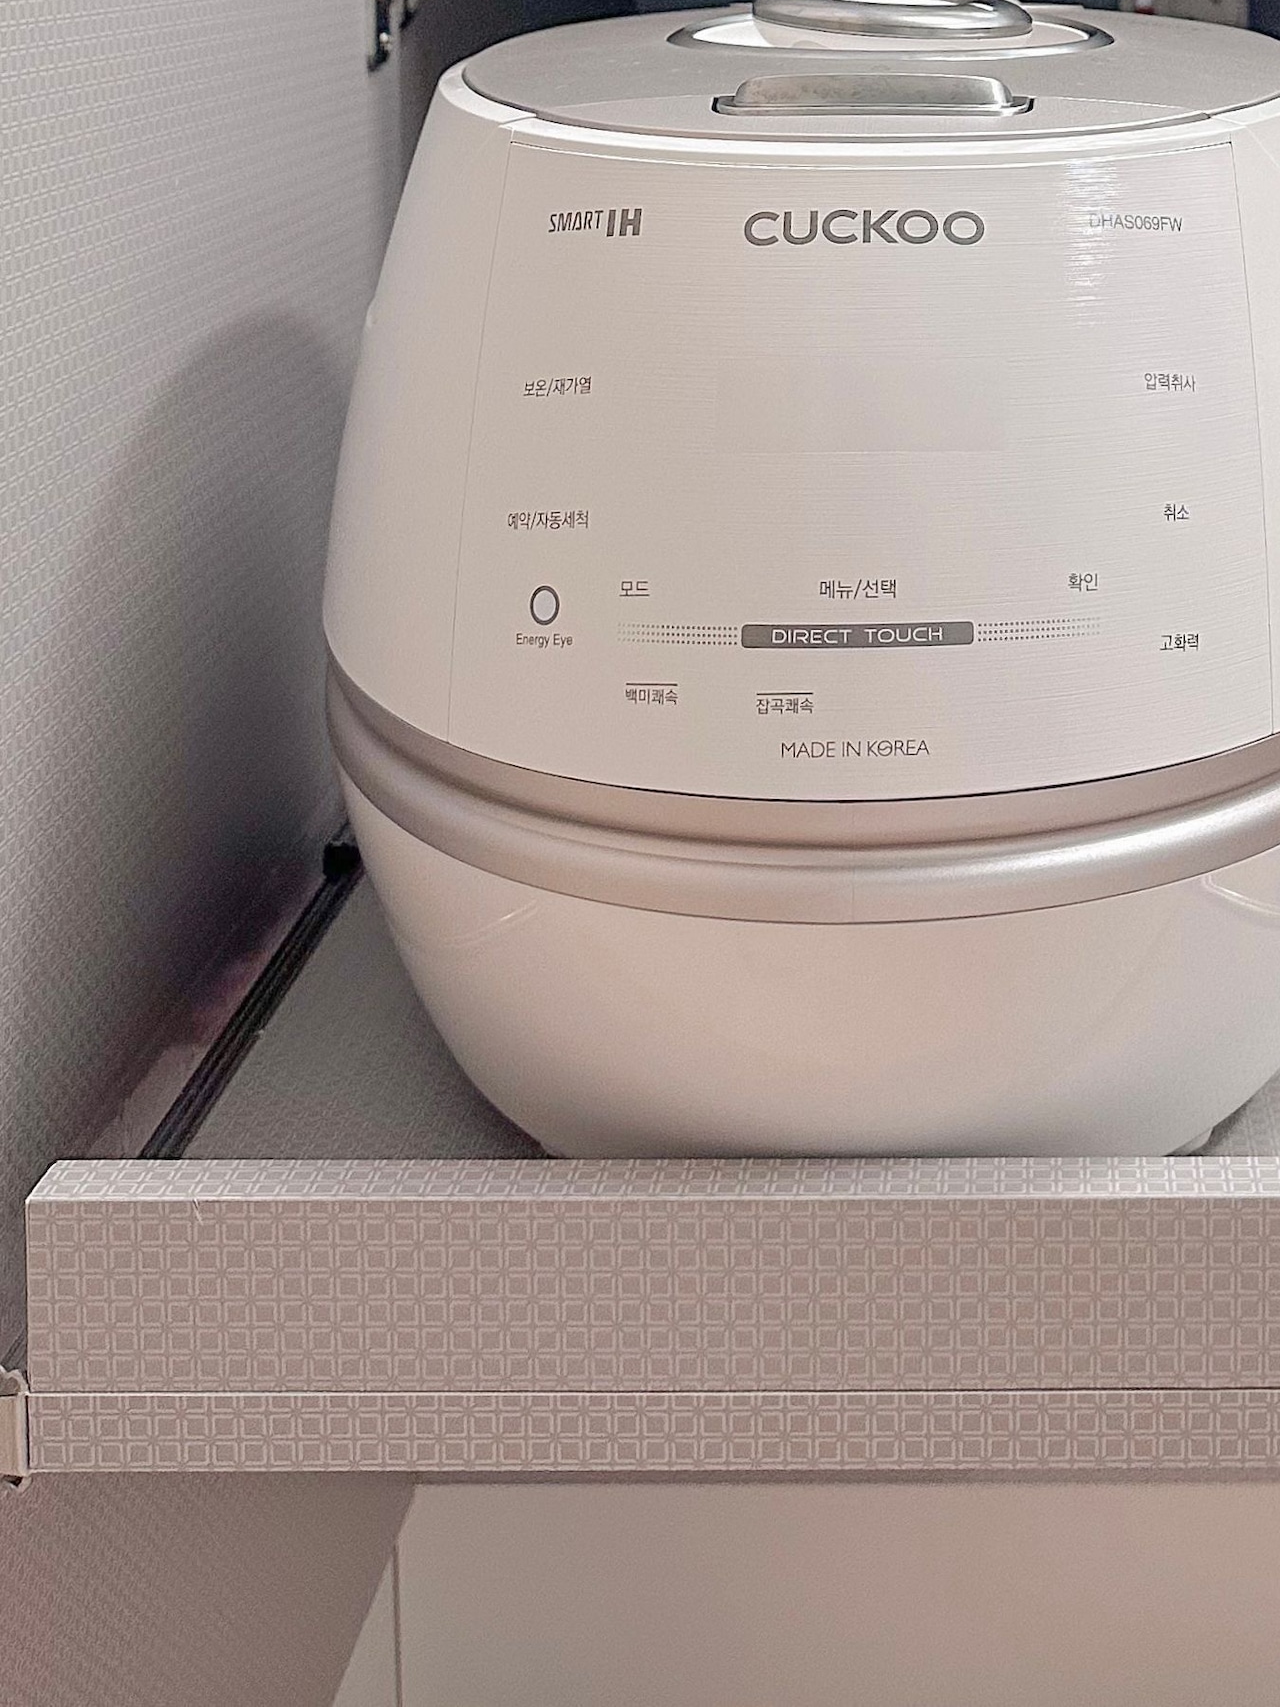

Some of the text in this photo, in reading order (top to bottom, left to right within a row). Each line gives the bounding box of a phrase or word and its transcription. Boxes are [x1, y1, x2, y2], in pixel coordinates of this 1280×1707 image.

[547, 208, 643, 238] SMART IH
[744, 209, 985, 247] CUCKOO
[1088, 212, 1183, 233] DHAS069FW
[523, 376, 592, 397] 보온/재가열
[1144, 372, 1196, 393] 압력취사
[507, 510, 589, 531] 예약/자동세척
[1163, 503, 1190, 522] 취소
[619, 580, 650, 596] 모드
[819, 578, 897, 600] 메뉴/선택
[1067, 572, 1099, 593] 확인
[516, 632, 574, 649] Energy Eye
[770, 626, 943, 644] DIRECT TOUCH
[1159, 633, 1200, 652] 고화력
[625, 688, 679, 706] 백미쾌속
[755, 697, 814, 715] 잡곡쾌속
[781, 739, 931, 759] MADE IN KOREA
